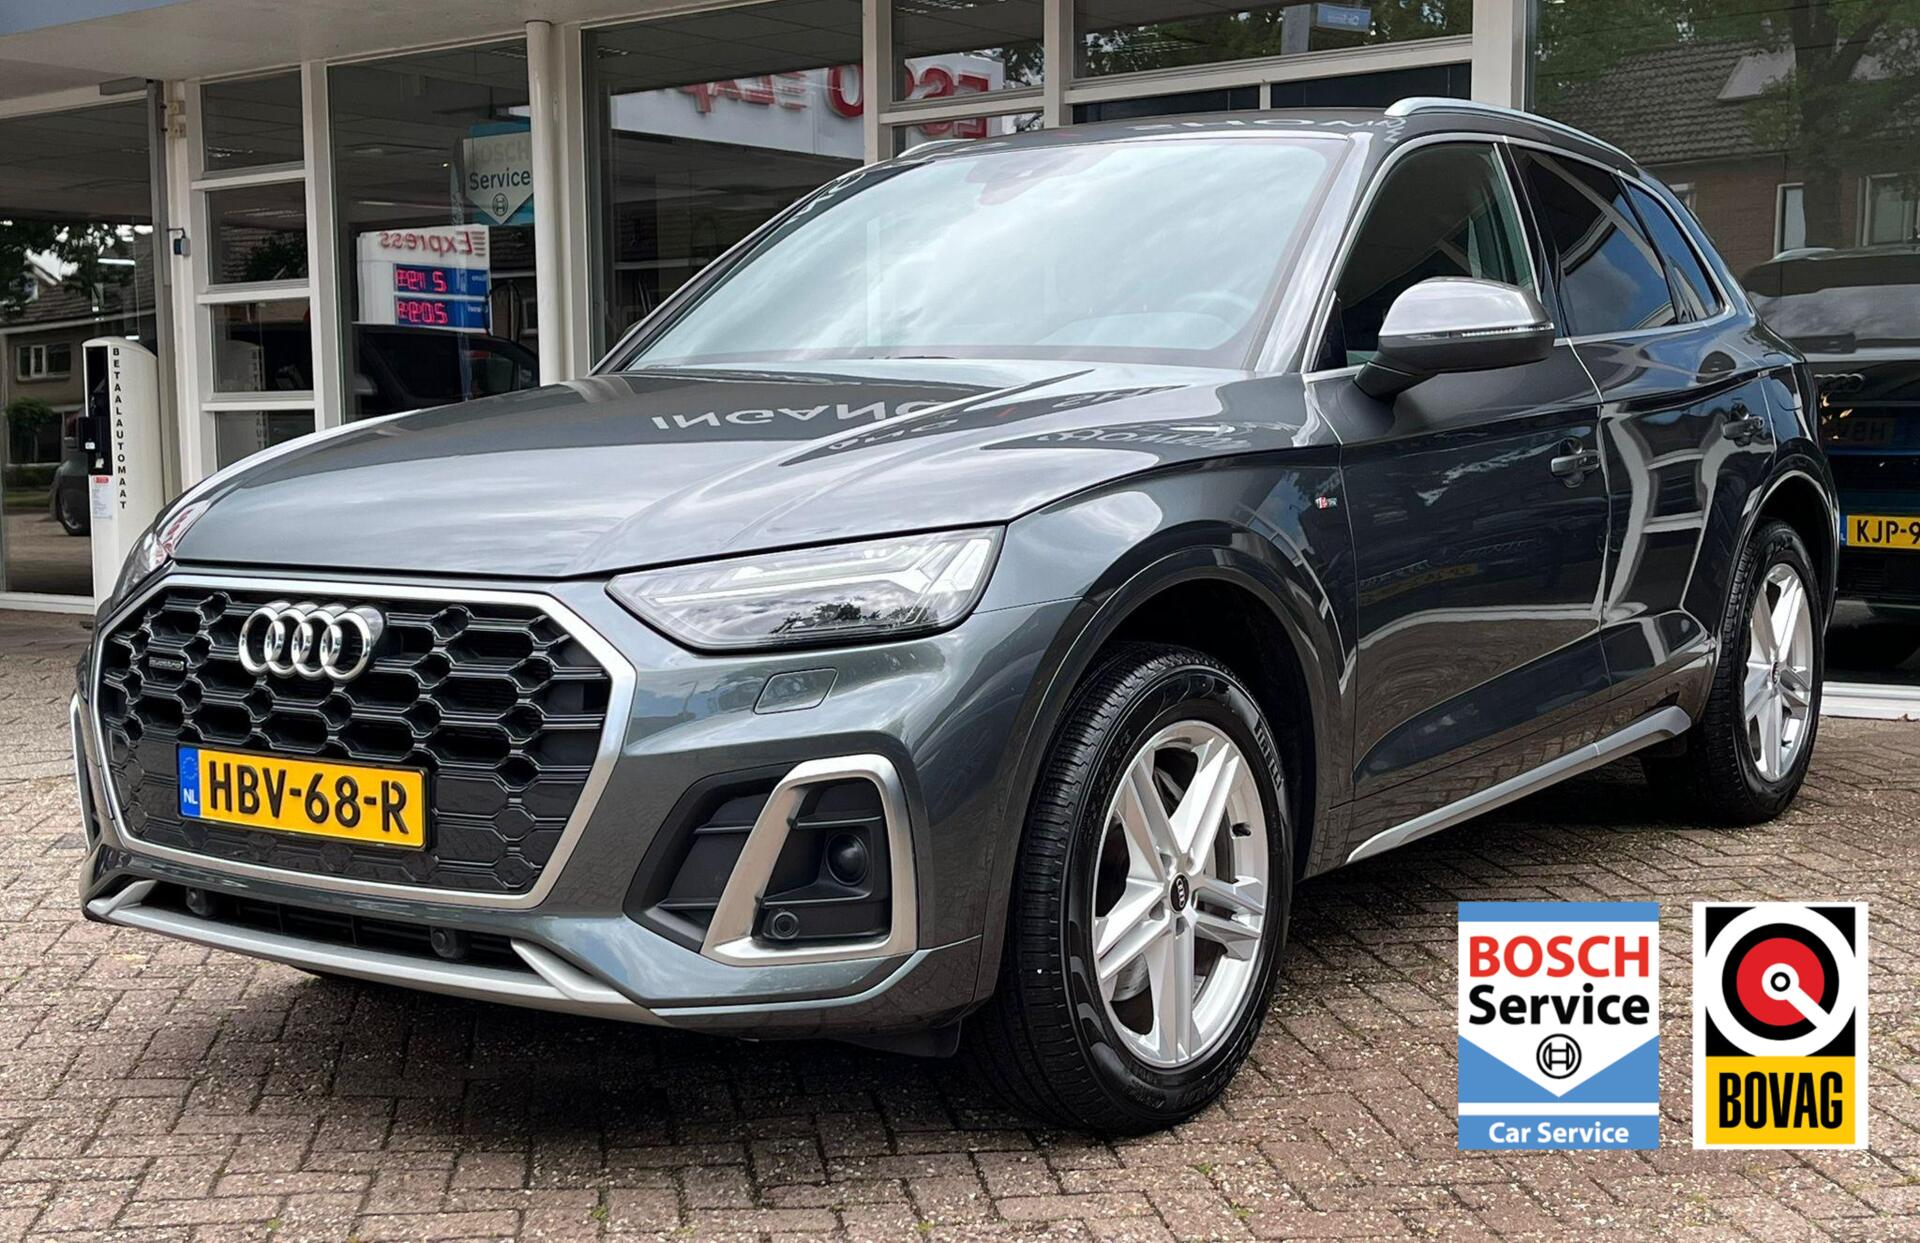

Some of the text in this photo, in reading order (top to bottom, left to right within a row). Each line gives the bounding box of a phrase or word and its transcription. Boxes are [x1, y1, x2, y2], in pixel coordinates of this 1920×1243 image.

[469, 167, 531, 191] Service
[113, 347, 127, 509] BETAALAUTOMAAT
[183, 788, 198, 805] NL
[209, 760, 409, 835] HBV-68-R
